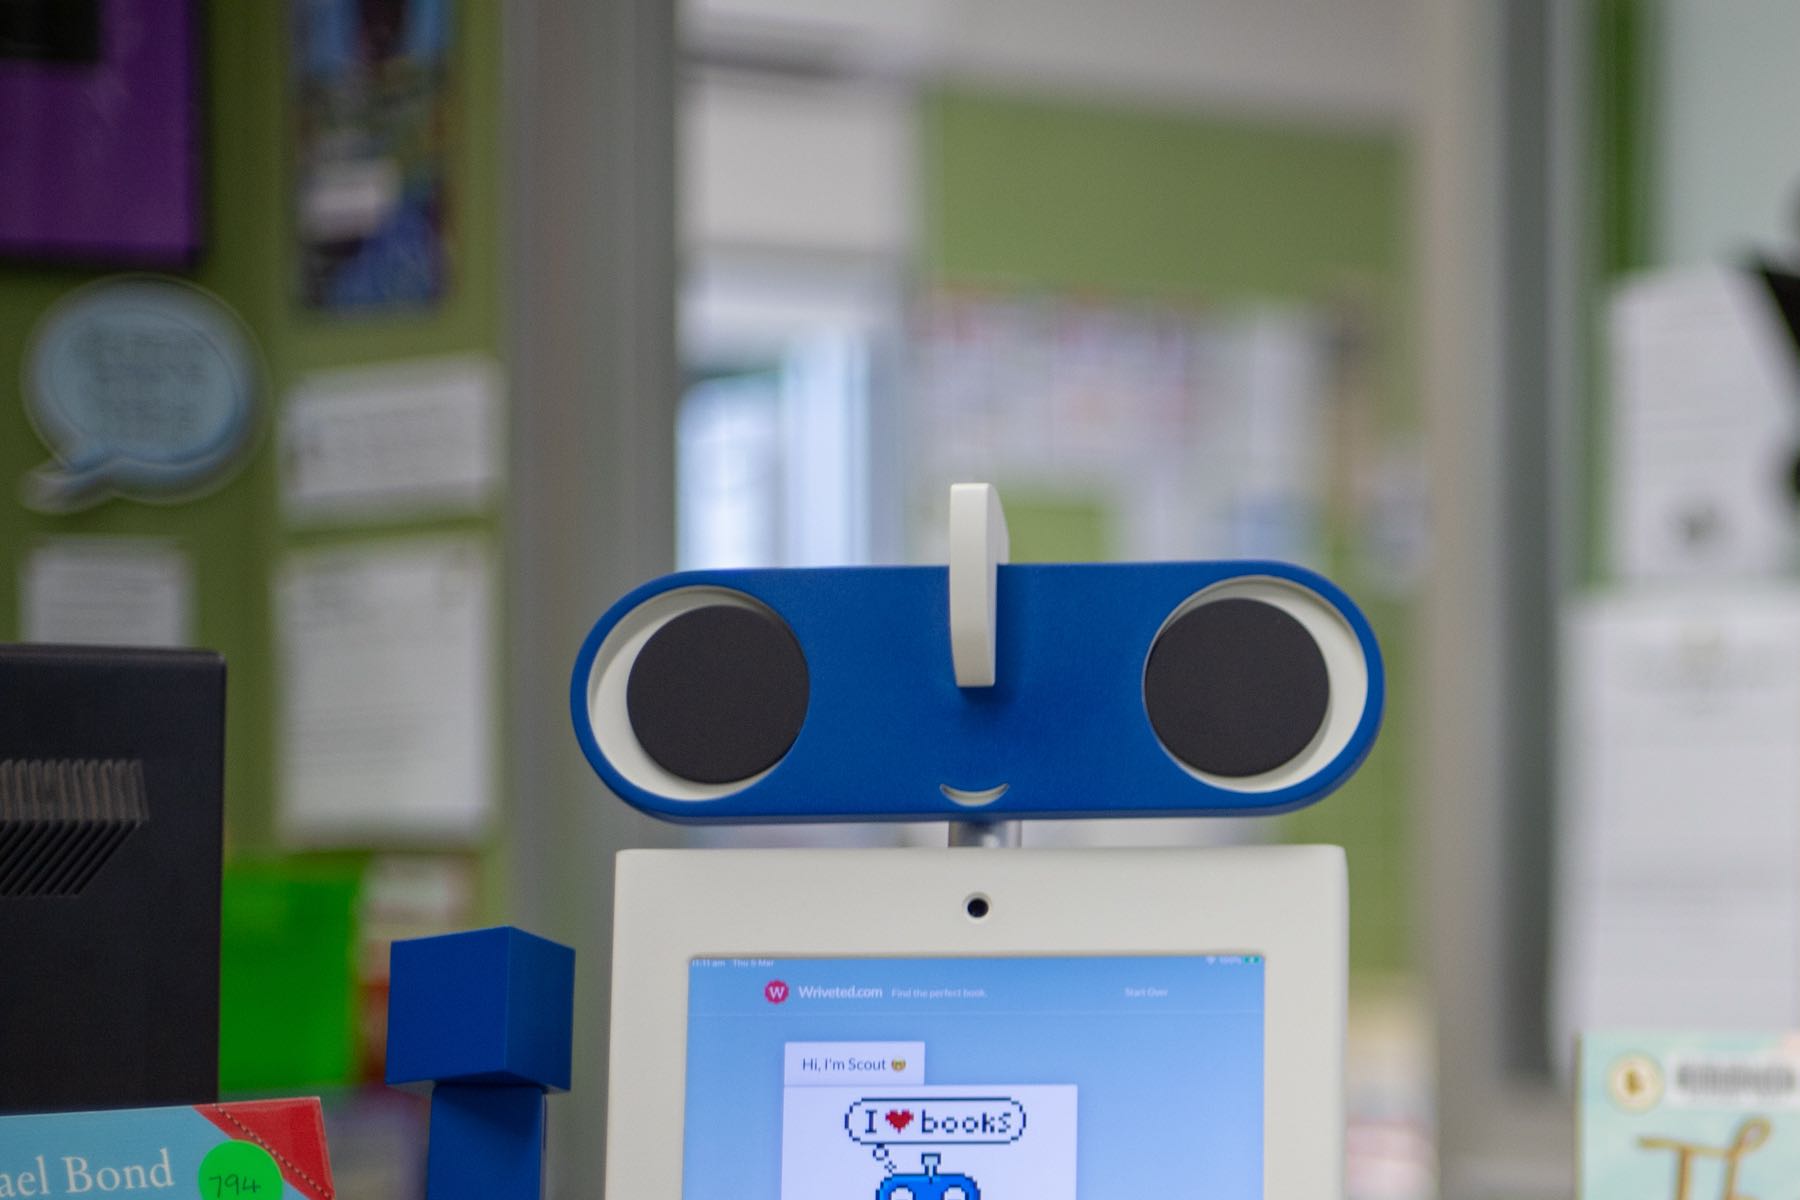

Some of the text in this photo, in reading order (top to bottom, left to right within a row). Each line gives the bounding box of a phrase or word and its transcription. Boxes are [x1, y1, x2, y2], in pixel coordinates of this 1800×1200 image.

[768, 986, 883, 1000] W Wriveted.com
[892, 988, 962, 1000] Find the perfect
[1125, 987, 1168, 998] Start Over
[802, 1057, 887, 1074] Hi, I'm Scout
[866, 1109, 1012, 1134] I books
[62, 1148, 175, 1195] Bond
[208, 1173, 262, 1196] 794
